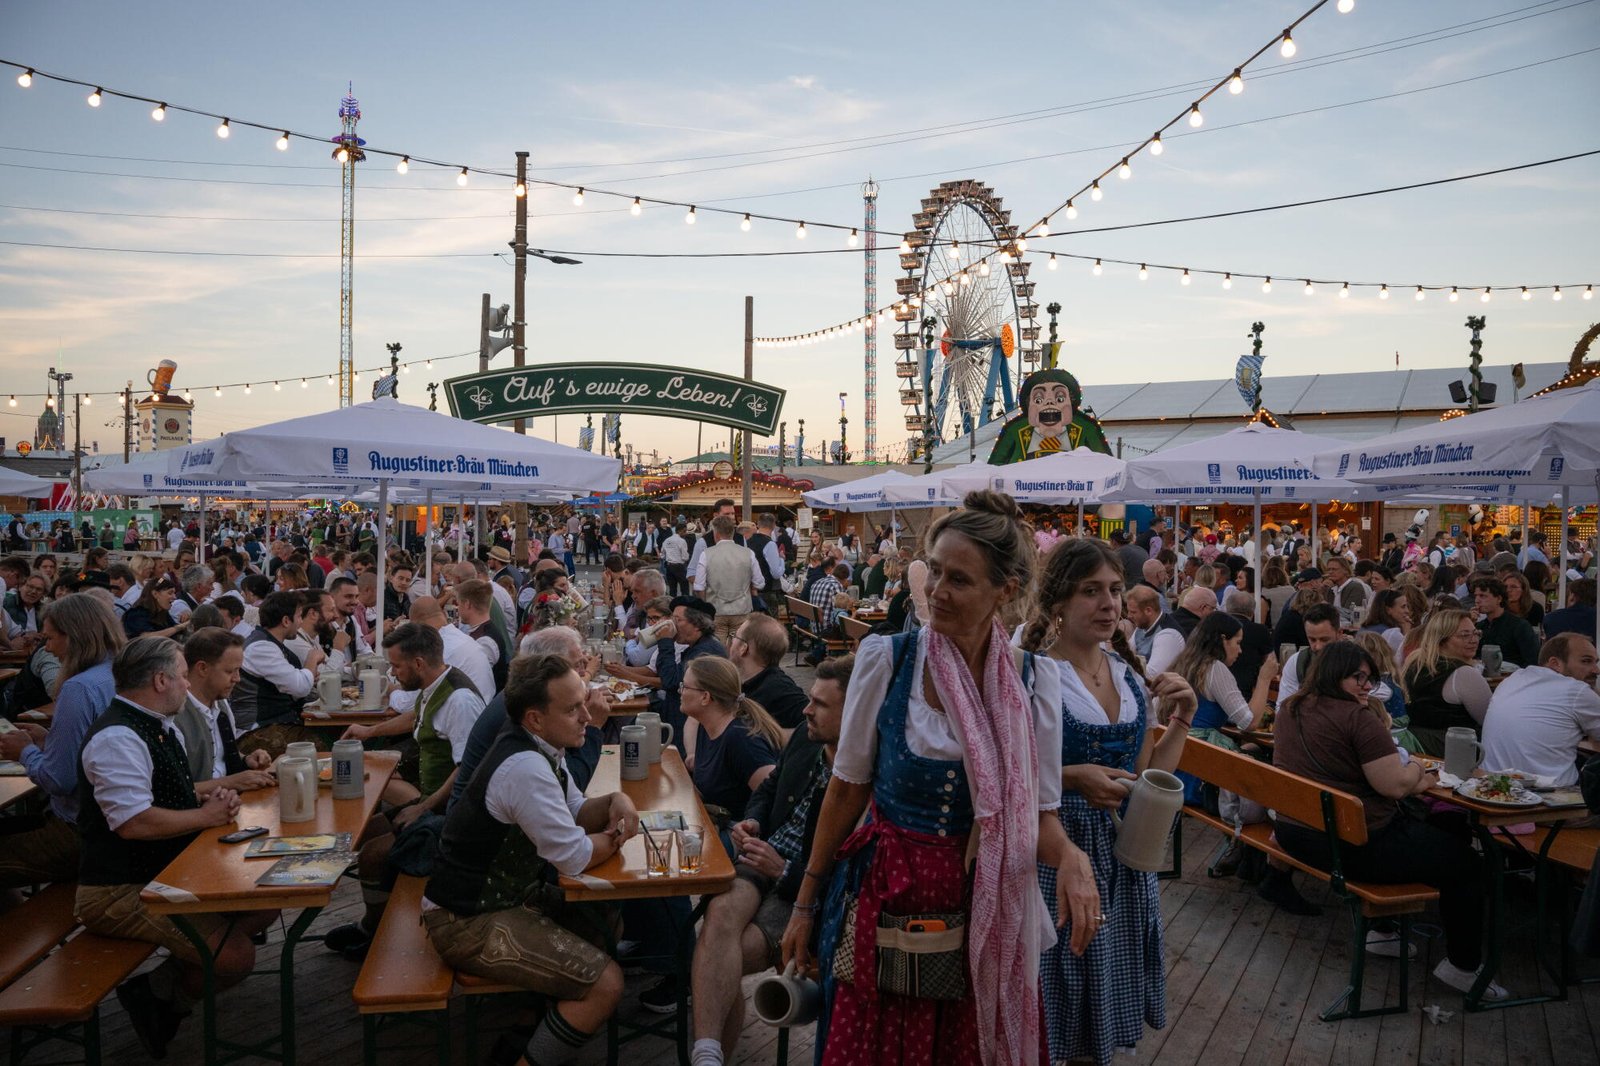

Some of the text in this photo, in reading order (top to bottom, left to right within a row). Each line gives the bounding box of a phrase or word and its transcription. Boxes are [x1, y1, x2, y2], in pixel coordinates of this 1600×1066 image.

[585, 378, 651, 403] ewige
[656, 376, 742, 408] Leben!
[1433, 442, 1474, 463] München
[486, 458, 540, 478] München
